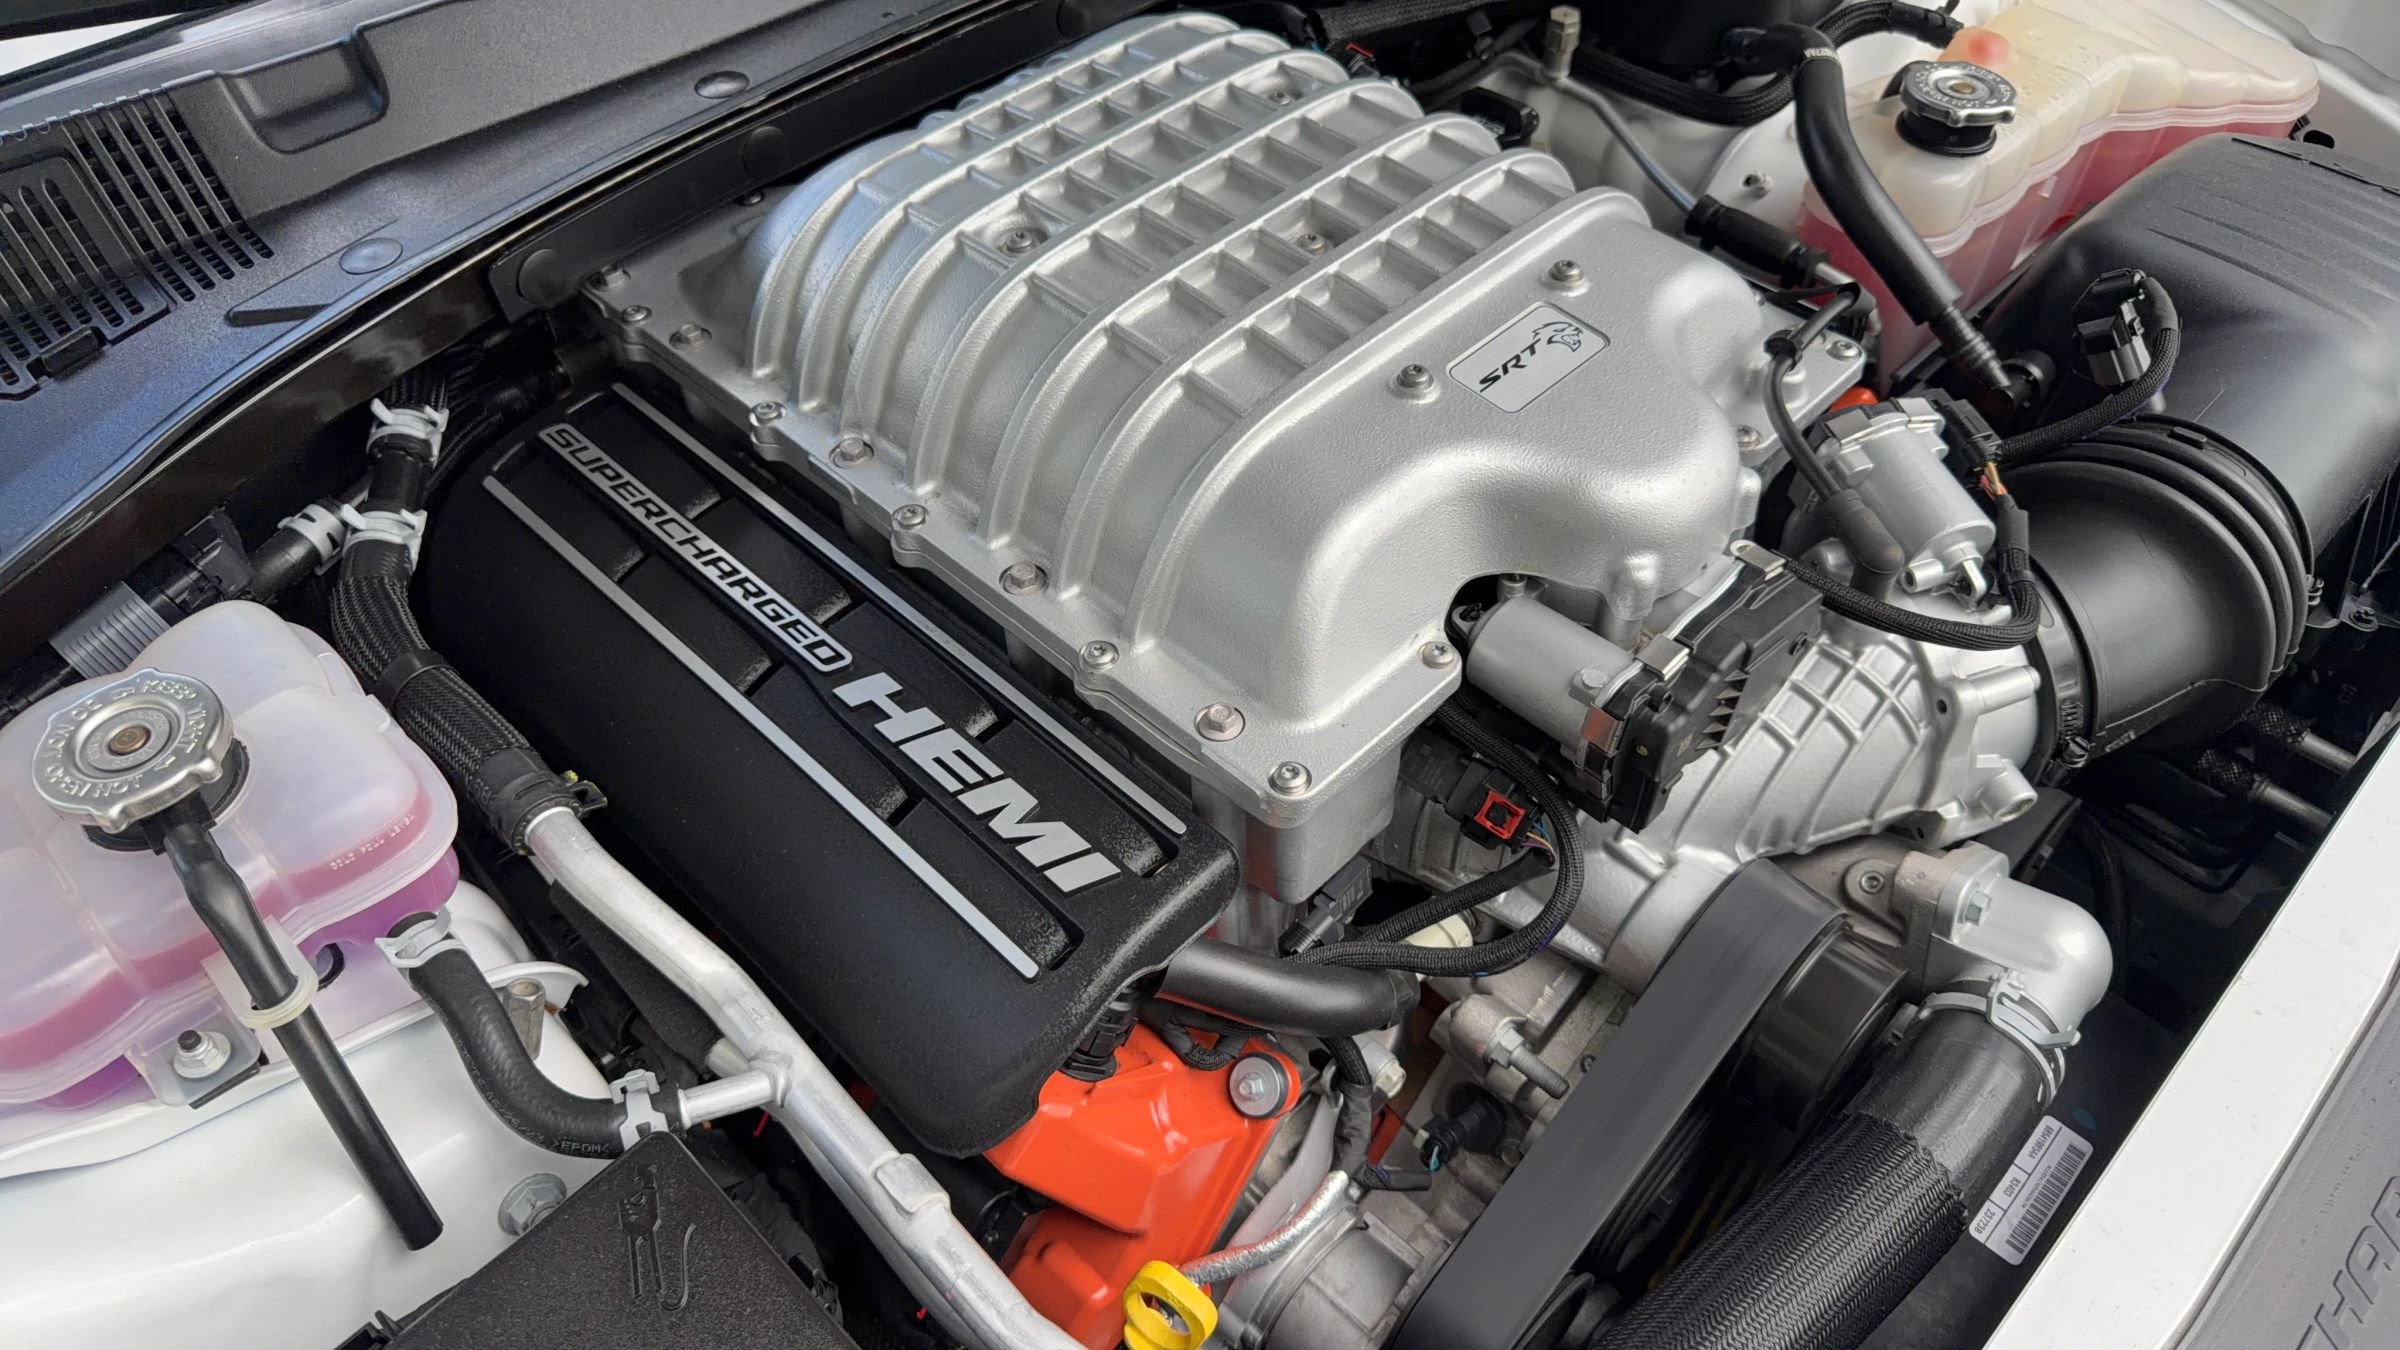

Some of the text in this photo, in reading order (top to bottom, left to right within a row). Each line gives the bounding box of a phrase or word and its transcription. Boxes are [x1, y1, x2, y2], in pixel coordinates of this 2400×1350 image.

[1479, 338, 1541, 393] SRT
[546, 428, 847, 664] SUPERCHARGED
[832, 672, 1121, 893] HEMI
